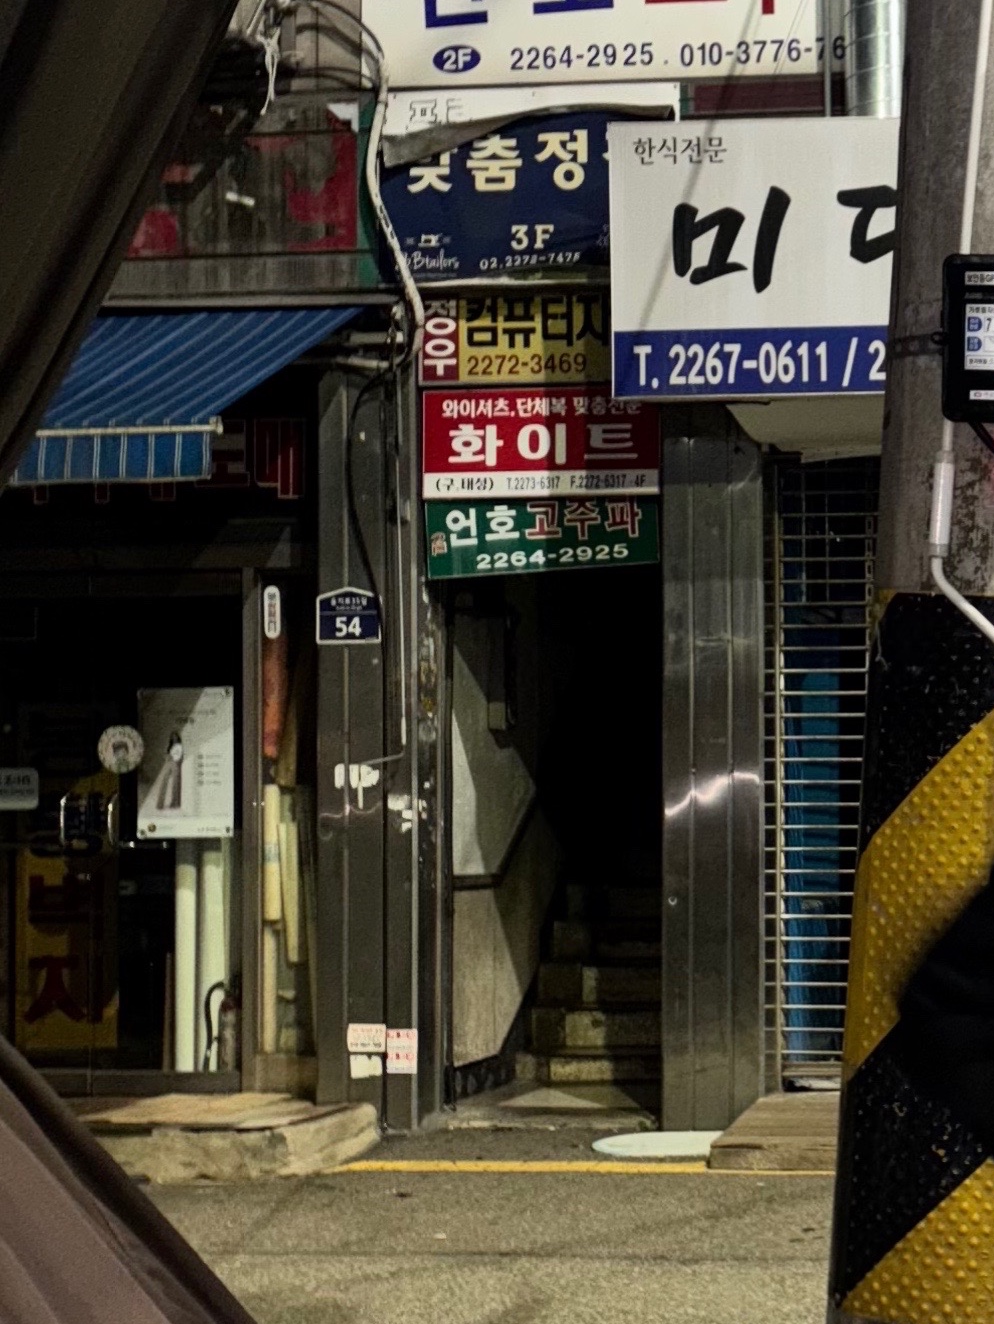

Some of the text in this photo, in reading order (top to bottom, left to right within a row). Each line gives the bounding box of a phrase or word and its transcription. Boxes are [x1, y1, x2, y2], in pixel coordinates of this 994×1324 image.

[442, 48, 472, 72] 2F
[509, 42, 654, 71] 2264-2925
[632, 136, 728, 166] 한식전문
[466, 353, 588, 377] 2272-3469
[669, 340, 828, 386] 2267-0611
[447, 423, 639, 467] 화이트
[476, 543, 630, 570] 2264-2925
[335, 616, 362, 638] 54
